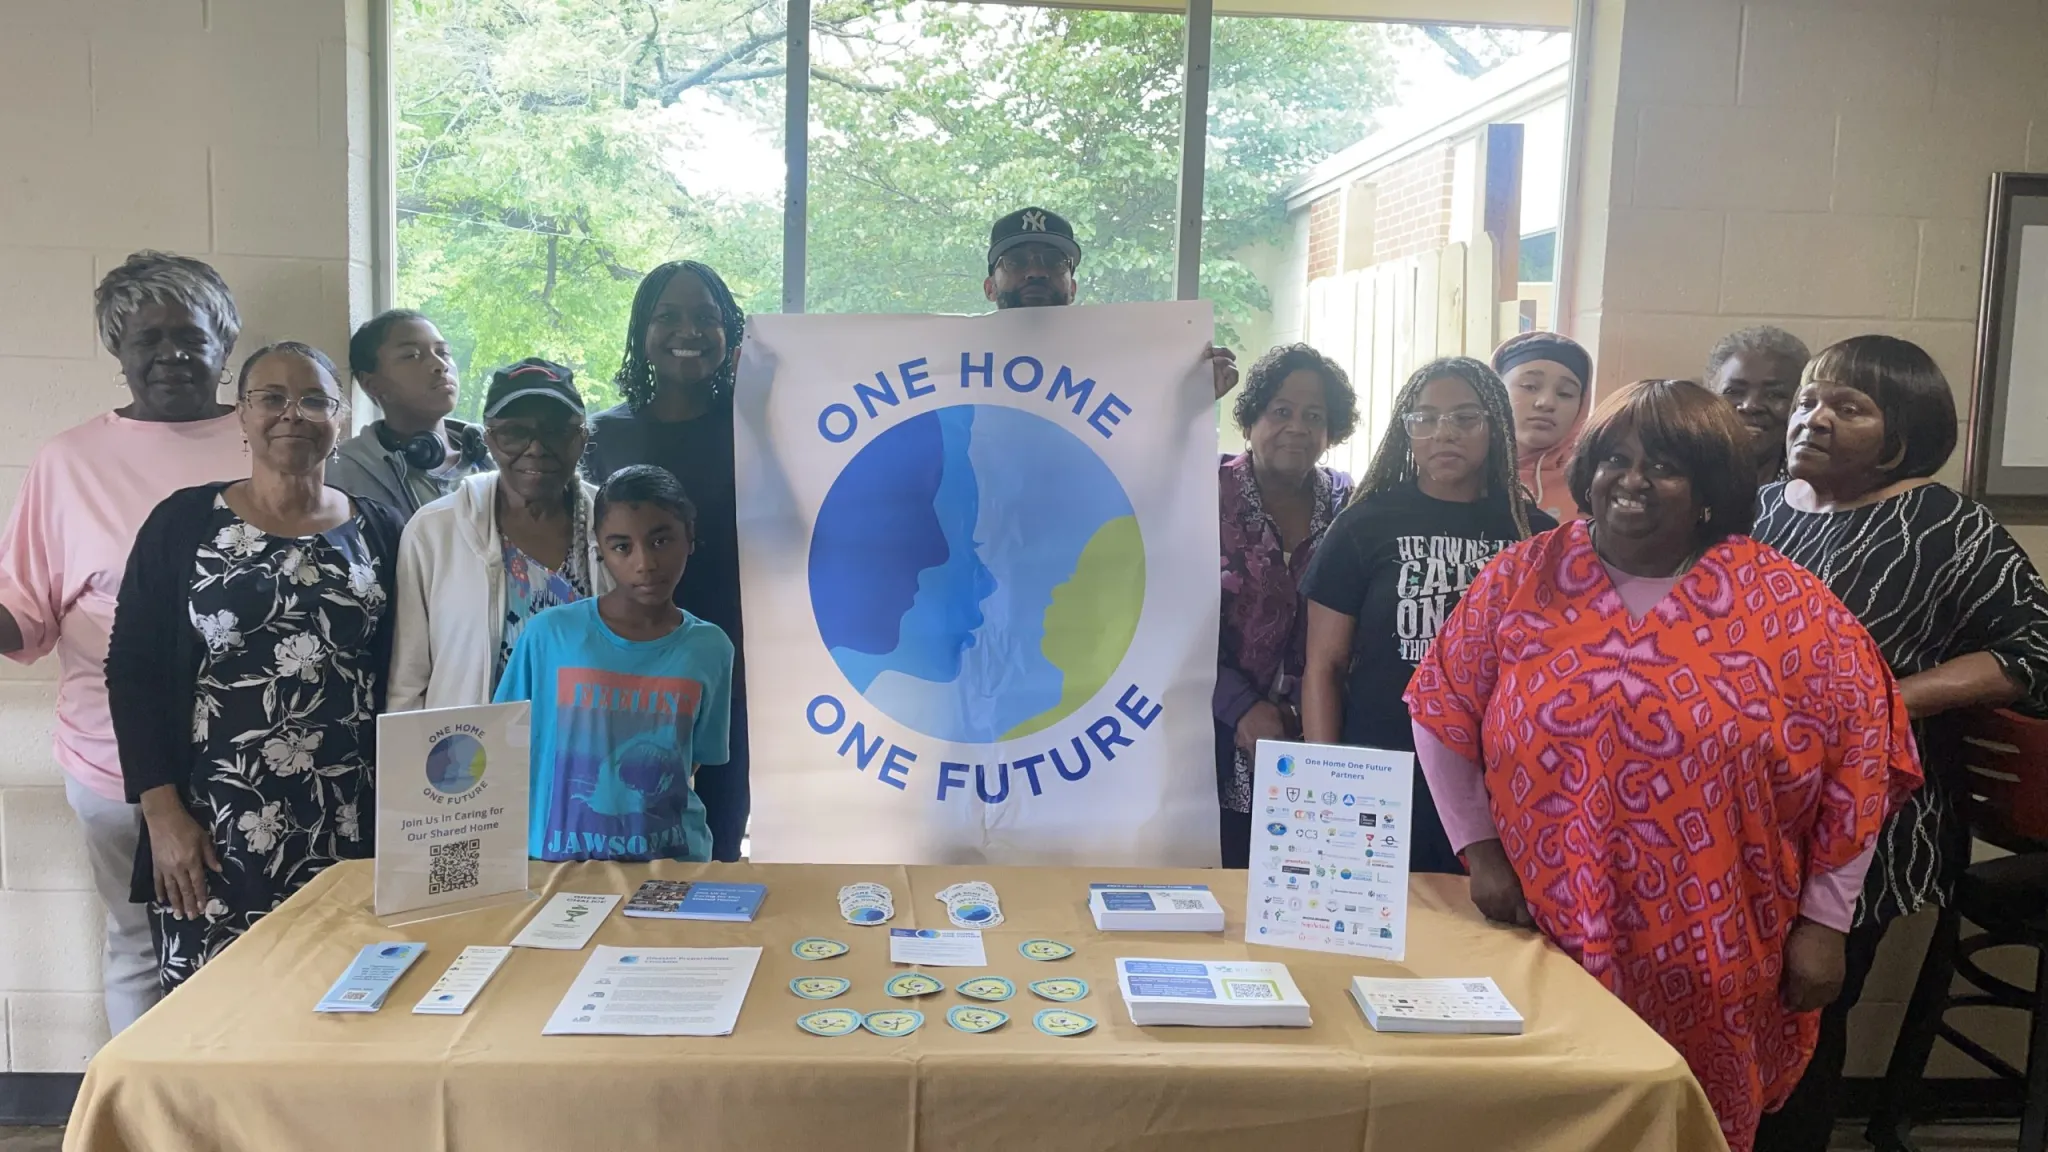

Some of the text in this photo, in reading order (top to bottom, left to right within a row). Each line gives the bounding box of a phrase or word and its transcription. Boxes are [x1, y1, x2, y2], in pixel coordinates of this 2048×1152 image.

[818, 352, 1133, 443] ONE HOME
[1428, 536, 1490, 567] OWNS
[1397, 594, 1447, 640] ON
[428, 724, 486, 743] ONE HOME
[806, 683, 1164, 804] ONE FUTURE
[1323, 760, 1346, 768] Home
[1365, 763, 1392, 772] Future
[1331, 771, 1365, 780] Partners
[423, 780, 488, 805] ONE FUTURE
[401, 819, 422, 830] Join
[425, 816, 439, 825] Us
[454, 809, 487, 819] Caring
[490, 806, 505, 815] for
[407, 821, 499, 842] Our Shared Home
